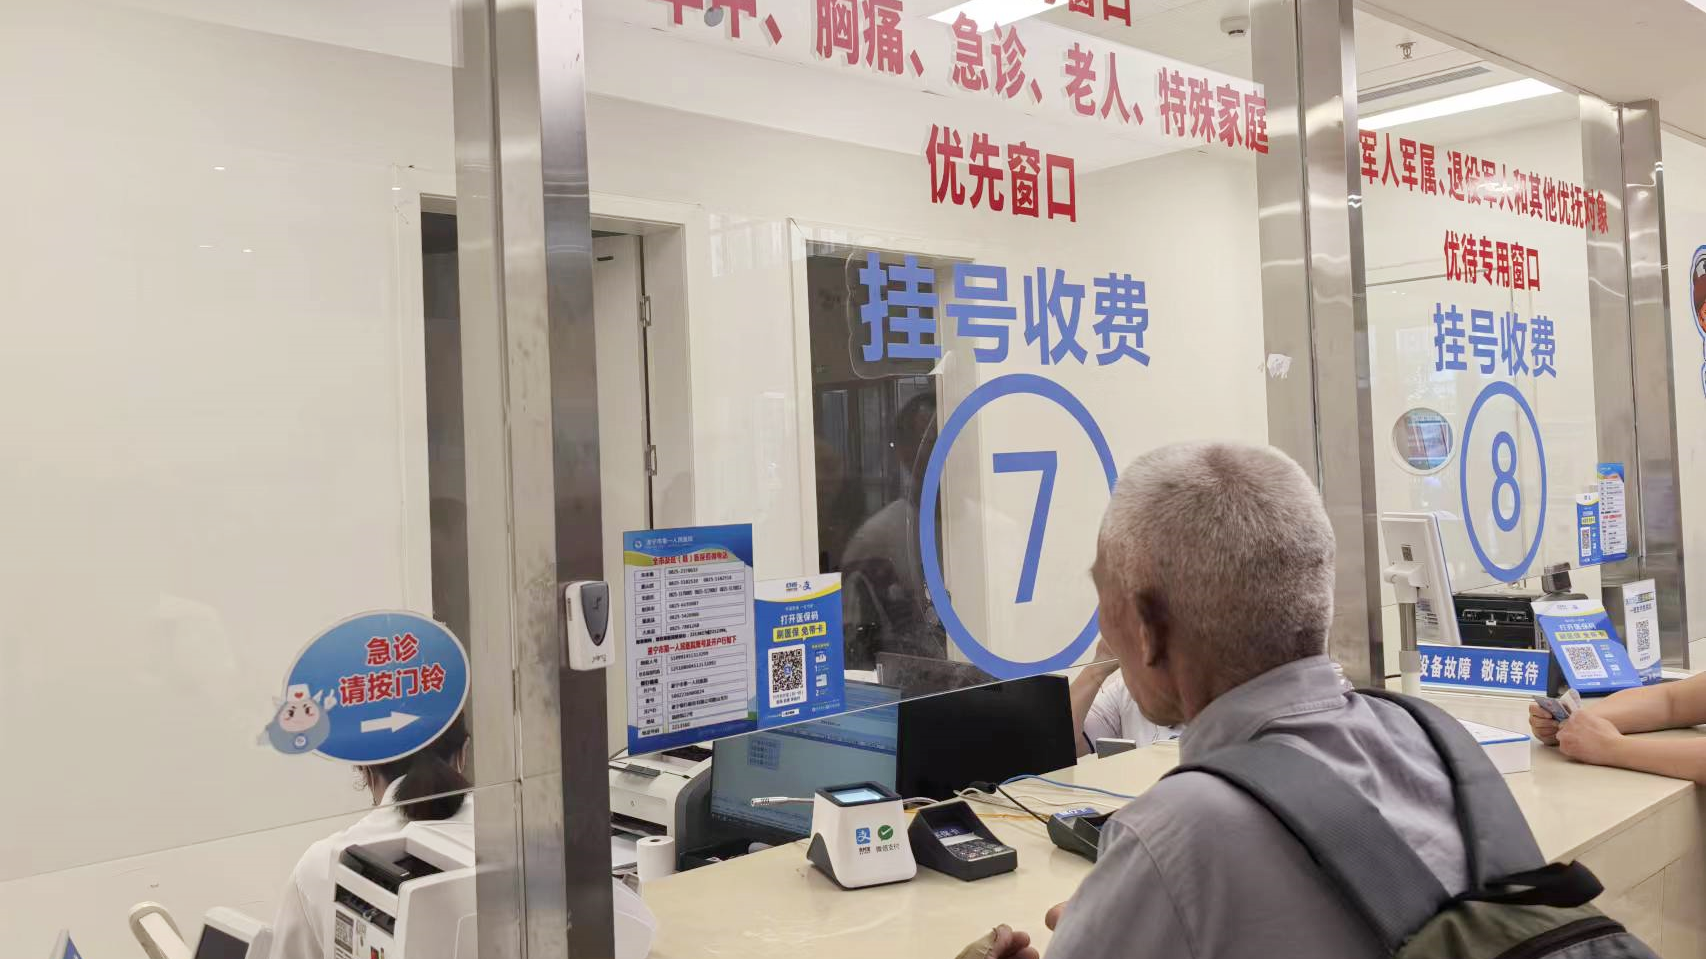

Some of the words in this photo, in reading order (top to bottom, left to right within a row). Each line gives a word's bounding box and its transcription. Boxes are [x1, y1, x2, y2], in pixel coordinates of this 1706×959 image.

[925, 124, 1077, 223] 优先窗口
[1444, 230, 1541, 292] 优待专用窗口
[859, 252, 1150, 367] 挂号收费
[1433, 302, 1557, 378] 挂号收费
[1491, 430, 1521, 532] 8
[992, 450, 1058, 604] 7
[339, 663, 446, 707] 请按门铃
[366, 632, 419, 666] 急诊
[1419, 653, 1472, 681] 设备故障
[1481, 657, 1540, 685] 敬请等待
